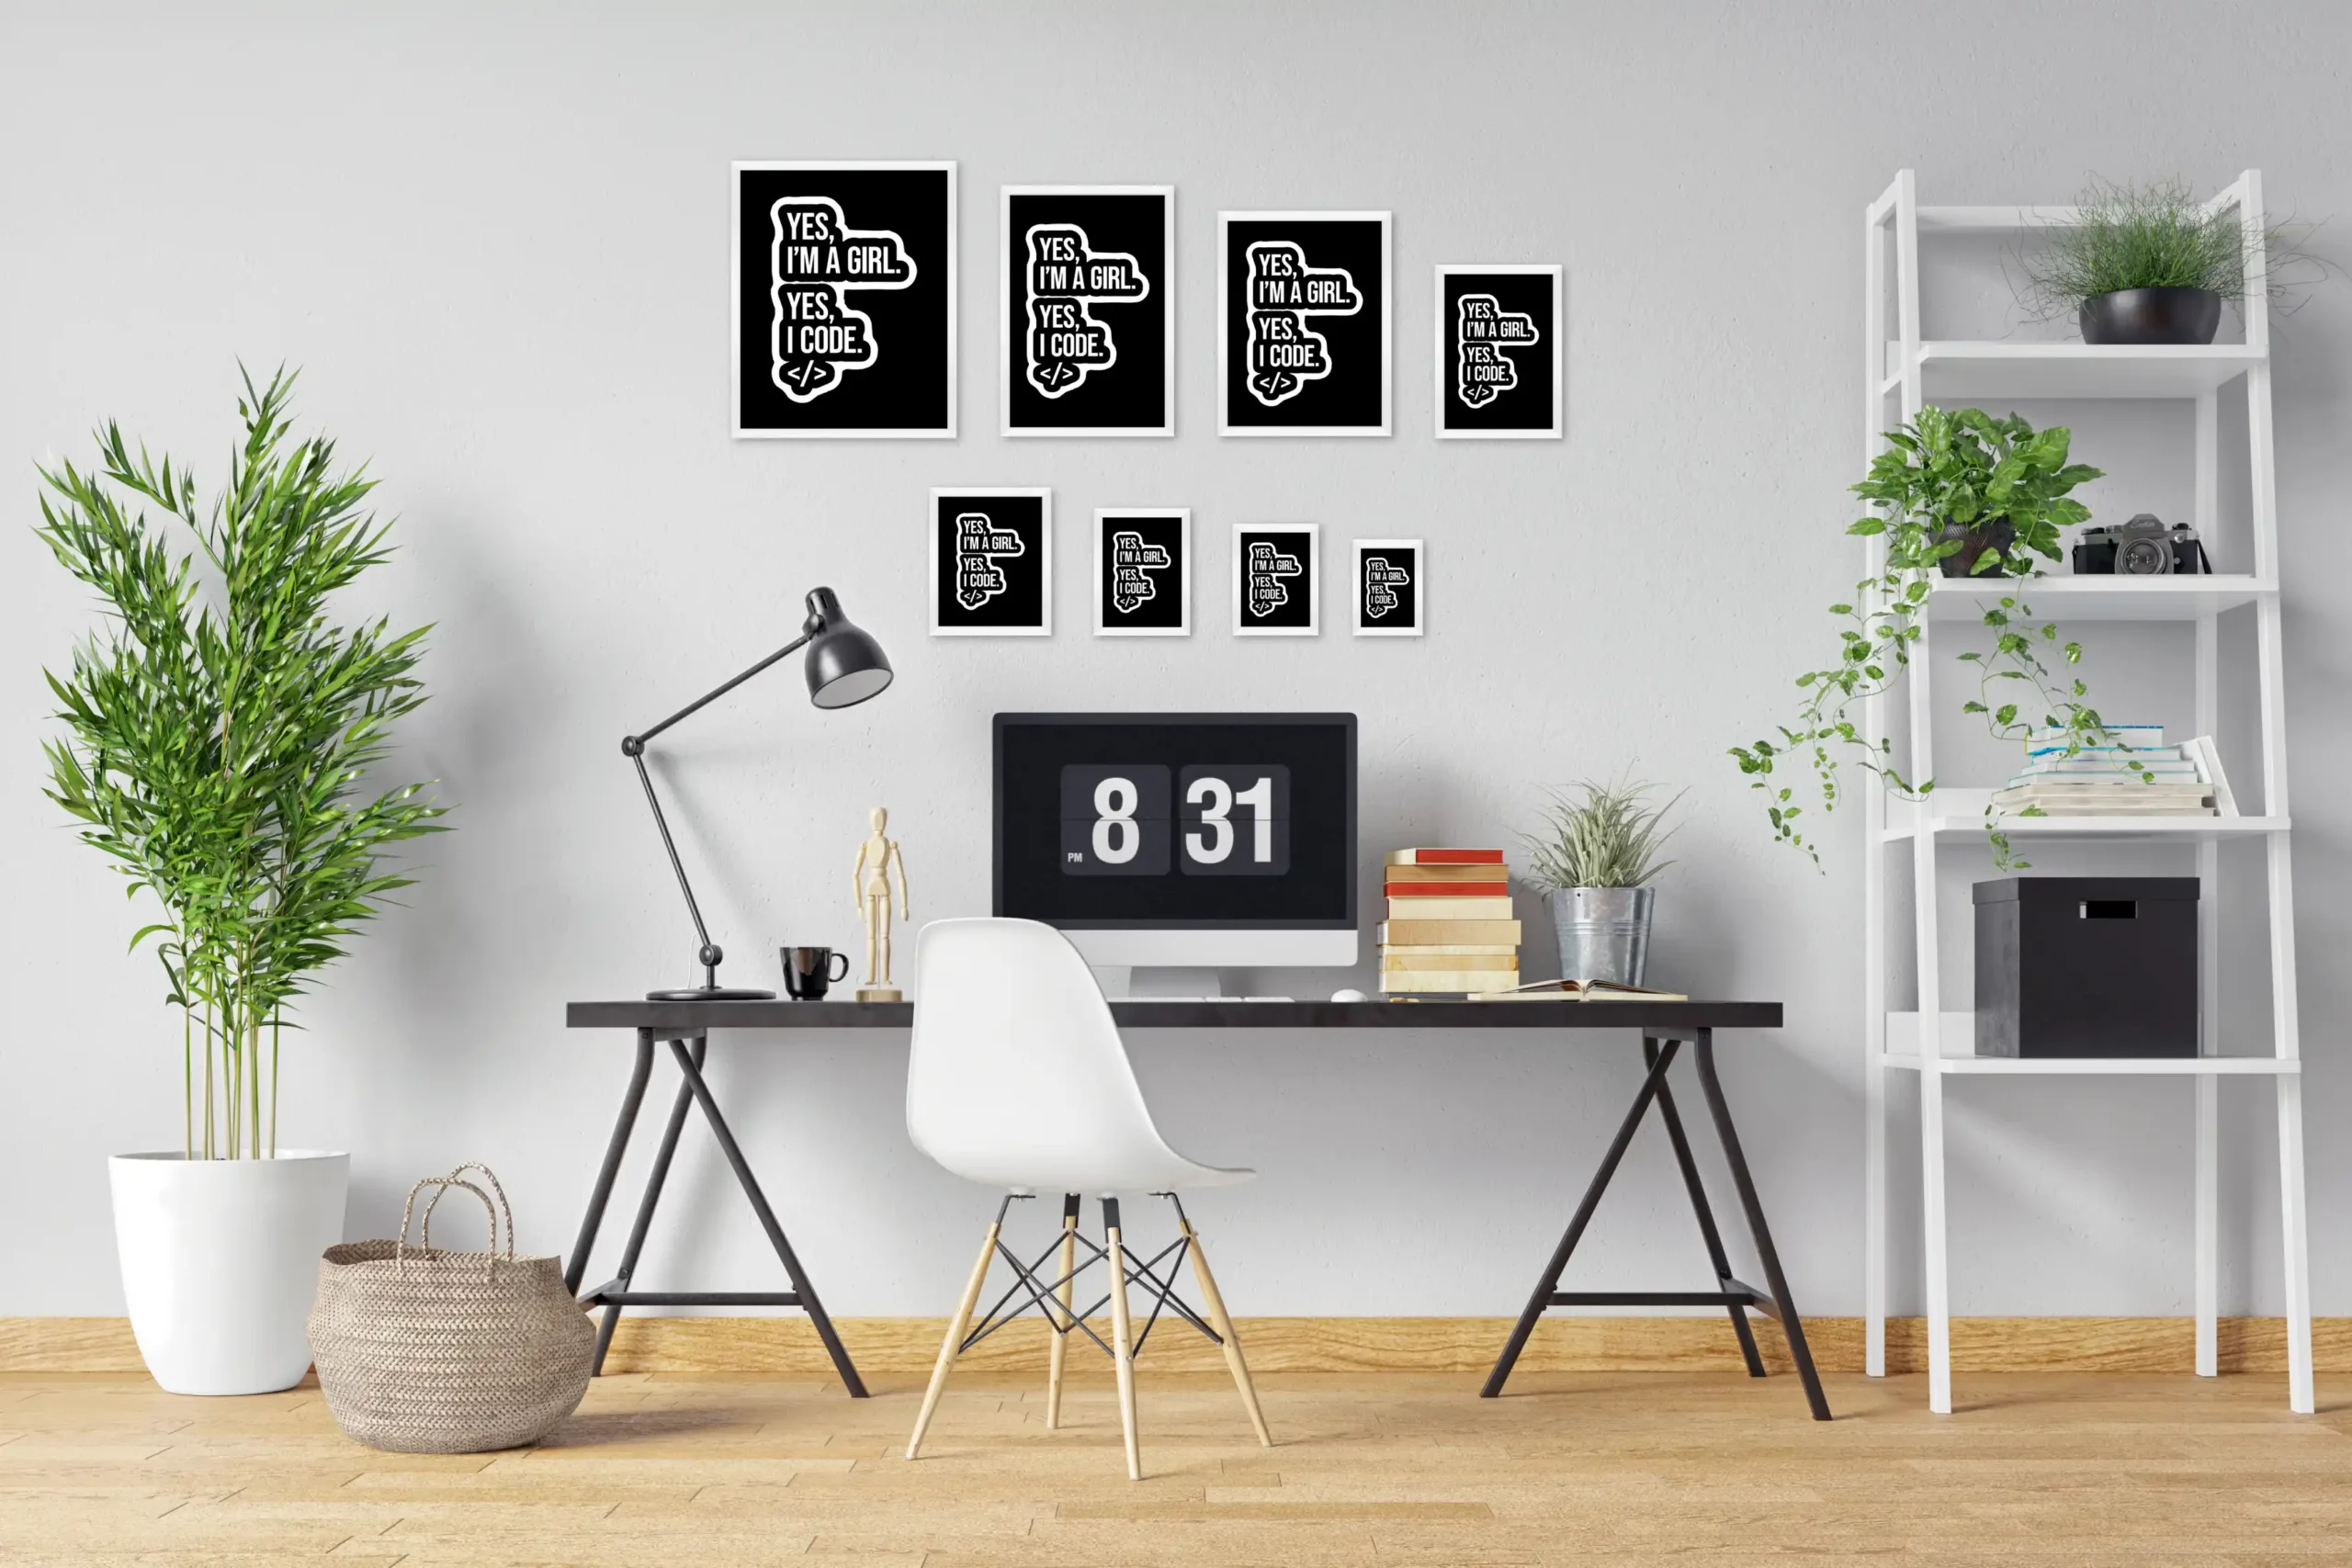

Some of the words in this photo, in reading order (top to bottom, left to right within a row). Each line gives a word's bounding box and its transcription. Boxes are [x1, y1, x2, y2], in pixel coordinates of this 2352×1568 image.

[786, 212, 834, 244] YES,
[1039, 237, 1080, 265] YES,
[787, 245, 819, 274] I'M
[825, 246, 841, 274] A
[847, 245, 901, 275] GIRL.
[1259, 254, 1297, 280] YES,
[1040, 265, 1067, 289] I'M
[1072, 265, 1085, 289] A
[1091, 265, 1136, 290] GIRL.
[1260, 280, 1284, 303] I'M
[1290, 280, 1302, 303] A
[1307, 280, 1351, 303] GIRL.
[786, 291, 834, 324] YES,
[1466, 302, 1494, 321] YES,
[1039, 304, 1080, 333] YES,
[1259, 317, 1297, 344] YES,
[1467, 321, 1485, 337] I'M
[1488, 321, 1497, 337] A
[1500, 321, 1531, 337] GIRL.
[787, 326, 793, 354] I
[800, 325, 863, 354] CODE.
[1040, 333, 1045, 357] I
[1051, 333, 1103, 357] CODE.
[1260, 344, 1264, 367] I
[1270, 344, 1319, 367] CODE.
[1466, 346, 1494, 366] YES,
[1467, 366, 1471, 381] I
[1475, 366, 1510, 381] CODE.
[963, 520, 987, 536] YES,
[964, 536, 978, 550] I'M
[981, 536, 989, 550] A
[991, 536, 1017, 550] GIRL.
[1119, 537, 1138, 551] YES,
[1119, 550, 1133, 562] I'M
[1135, 551, 1141, 562] A
[1143, 550, 1165, 562] GIRL.
[1254, 547, 1272, 560] YES,
[963, 558, 987, 573] YES,
[1255, 559, 1267, 570] I'M
[1269, 560, 1274, 570] A
[1276, 559, 1296, 570] GIRL.
[1371, 562, 1385, 572] YES,
[964, 573, 967, 587] I
[970, 573, 1000, 587] CODE.
[1119, 569, 1138, 582] YES,
[1254, 576, 1272, 589] YES,
[1371, 571, 1381, 581] I'M
[1382, 571, 1387, 581] A
[1388, 571, 1405, 581] GIRL.
[1119, 582, 1122, 593] I
[1125, 582, 1149, 594] CODE.
[1255, 589, 1258, 599] I
[1260, 589, 1283, 600] CODE.
[1371, 585, 1385, 595] YES,
[1371, 595, 1374, 604] I
[1374, 595, 1394, 604] CODE.
[1091, 777, 1140, 863] 8
[1185, 777, 1272, 863] 31
[1068, 852, 1082, 863] PM
